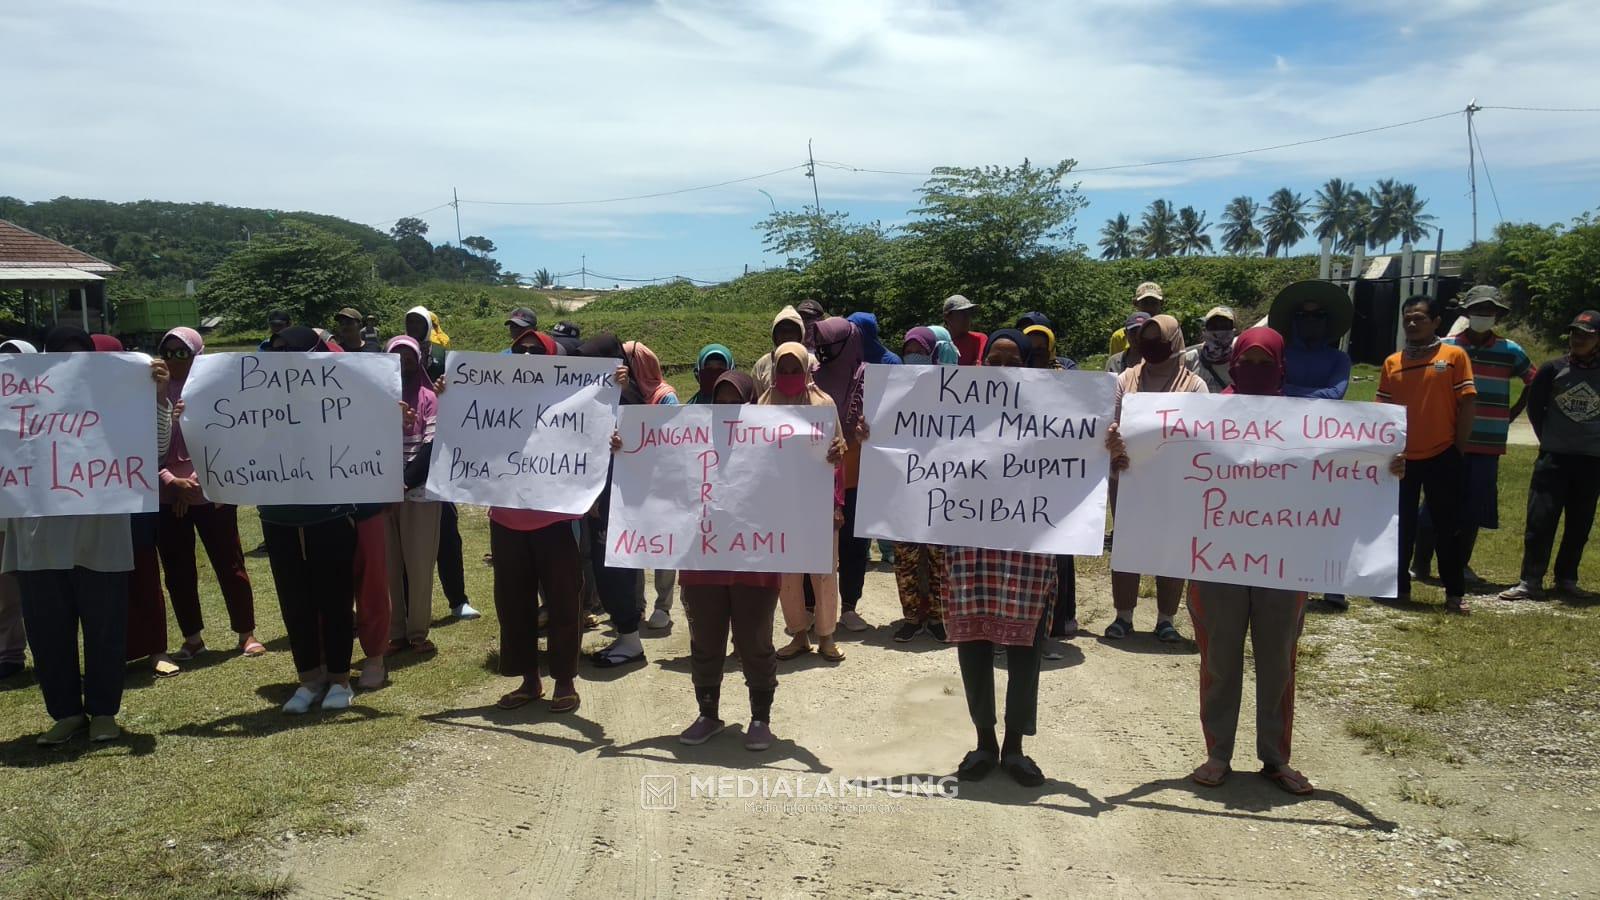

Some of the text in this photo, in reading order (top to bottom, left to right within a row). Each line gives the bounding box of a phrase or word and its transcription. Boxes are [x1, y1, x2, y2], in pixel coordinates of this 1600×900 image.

[239, 355, 343, 393] BAPAK
[453, 363, 614, 388] SEJAK ADA TAMBAK
[939, 367, 1020, 409] KAMI
[10, 404, 100, 440] TUTUP
[205, 397, 351, 429] SATPOL PP
[461, 399, 585, 434] ANAK KAMI
[894, 411, 1097, 441] MINTA MAKAN
[1156, 408, 1396, 444] TAMBAK UDANG
[623, 421, 710, 454] JANGAN
[723, 420, 794, 449] TUTUP
[50, 441, 153, 498] LAPAR
[329, 445, 385, 479] Kami
[450, 447, 586, 482] BISA SEKOLAH
[906, 453, 1086, 484] BAPAK BUPATI
[1184, 453, 1378, 485] Sumber Mata
[1202, 487, 1341, 530] PENCARIAN
[614, 529, 674, 555] NASI
